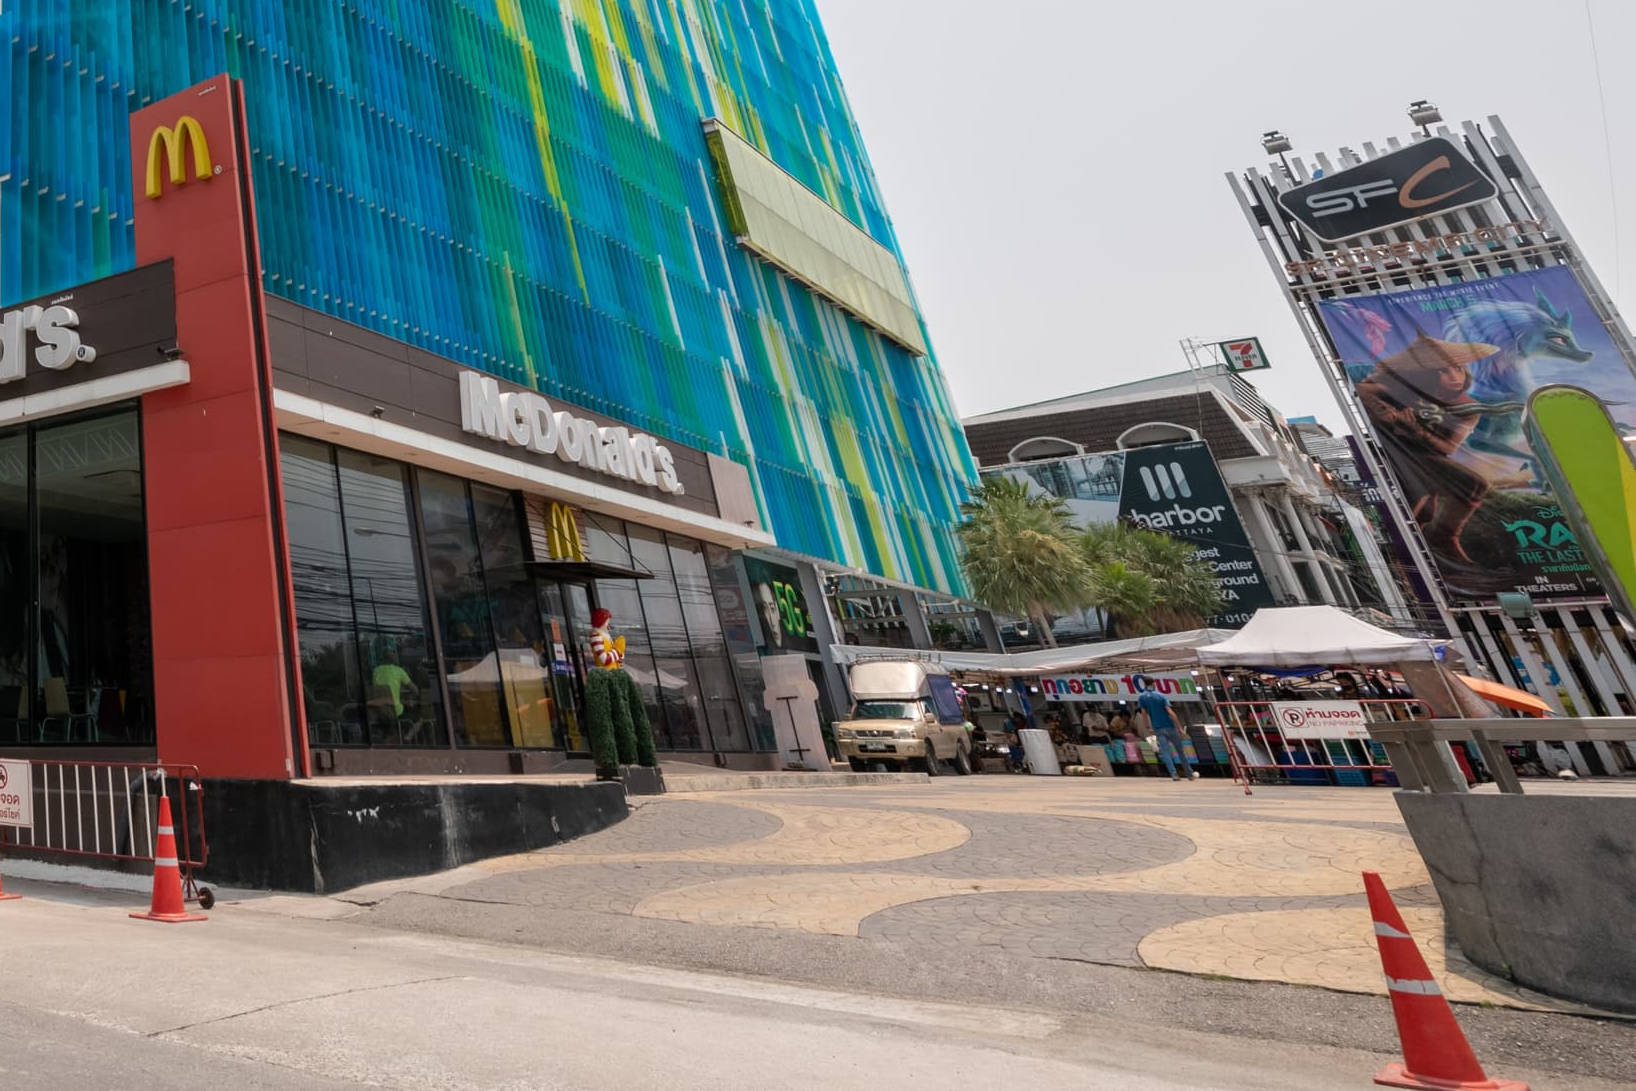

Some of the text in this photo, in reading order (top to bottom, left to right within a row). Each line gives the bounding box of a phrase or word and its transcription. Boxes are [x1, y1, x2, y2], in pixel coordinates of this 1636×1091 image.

[1306, 155, 1482, 218] SFC
[1334, 234, 1465, 268] CINEMA
[1475, 215, 1553, 242] CITY
[1420, 296, 1465, 312] MARCH
[1229, 342, 1253, 368] 7
[459, 370, 678, 493] McDonald's
[1131, 504, 1226, 529] harbor
[1208, 559, 1253, 574] Center
[1517, 549, 1583, 565] THE LAST
[1514, 583, 1578, 594] THEATERS
[1534, 575, 1549, 584] IN
[772, 580, 806, 638] 5G
[1042, 674, 1120, 700] ทุกอย่าง
[1155, 678, 1197, 695] บาท
[1304, 707, 1361, 719] ห้ามจอด
